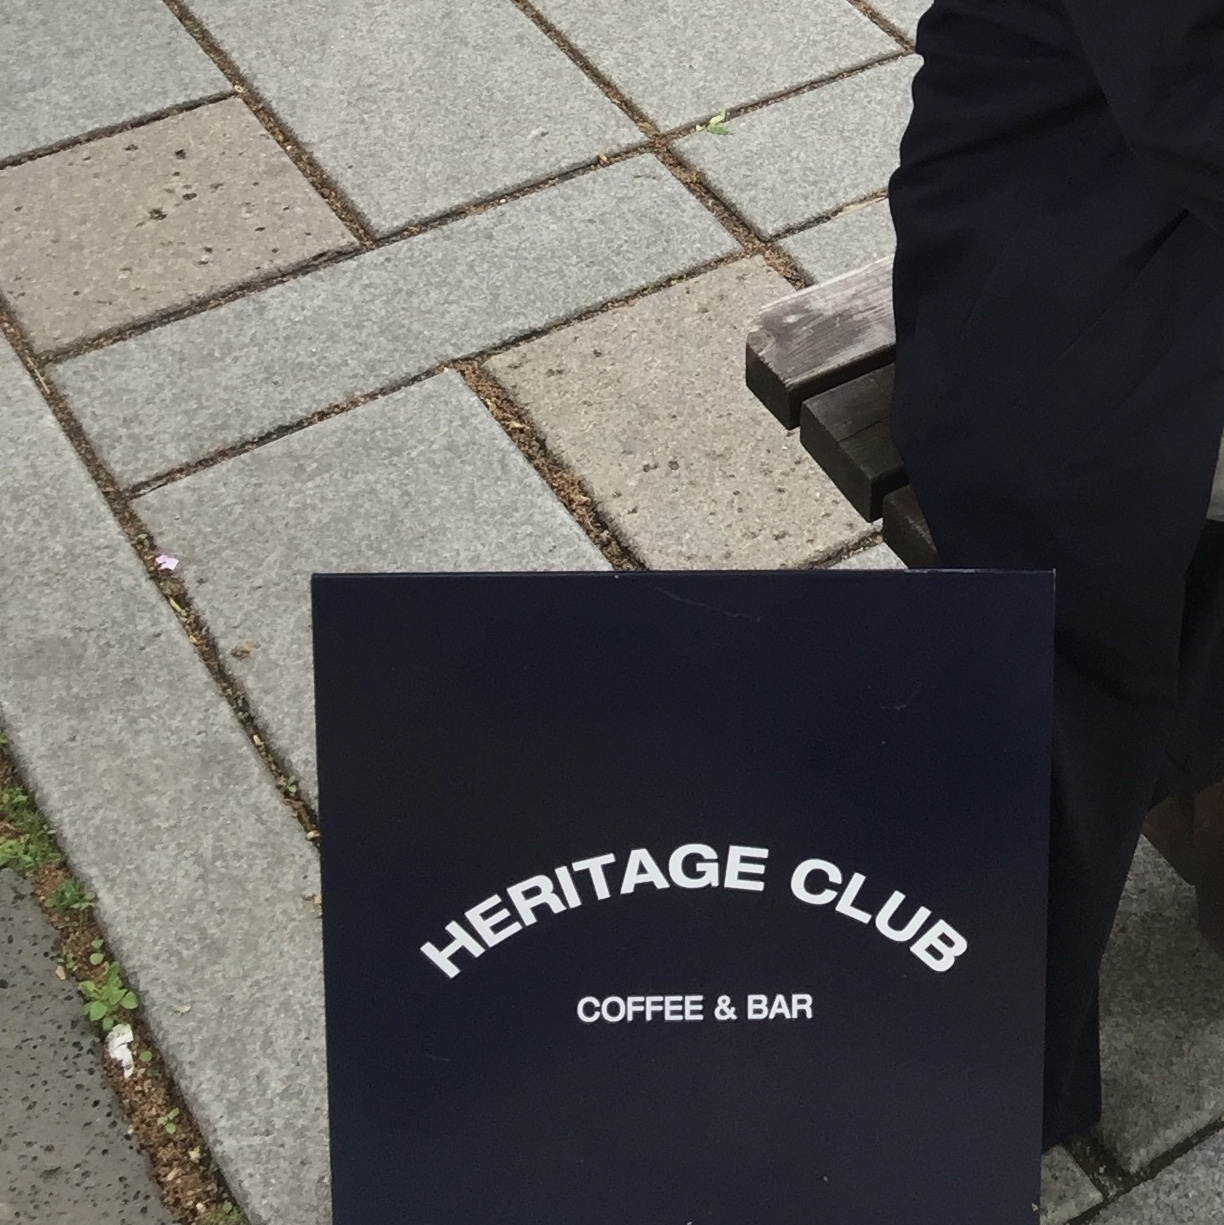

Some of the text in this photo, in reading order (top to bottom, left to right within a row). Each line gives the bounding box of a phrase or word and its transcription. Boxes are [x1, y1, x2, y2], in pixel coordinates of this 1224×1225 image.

[419, 842, 969, 979] HERITAGE CLUB
[576, 993, 814, 1023] COFFEE & BAR
